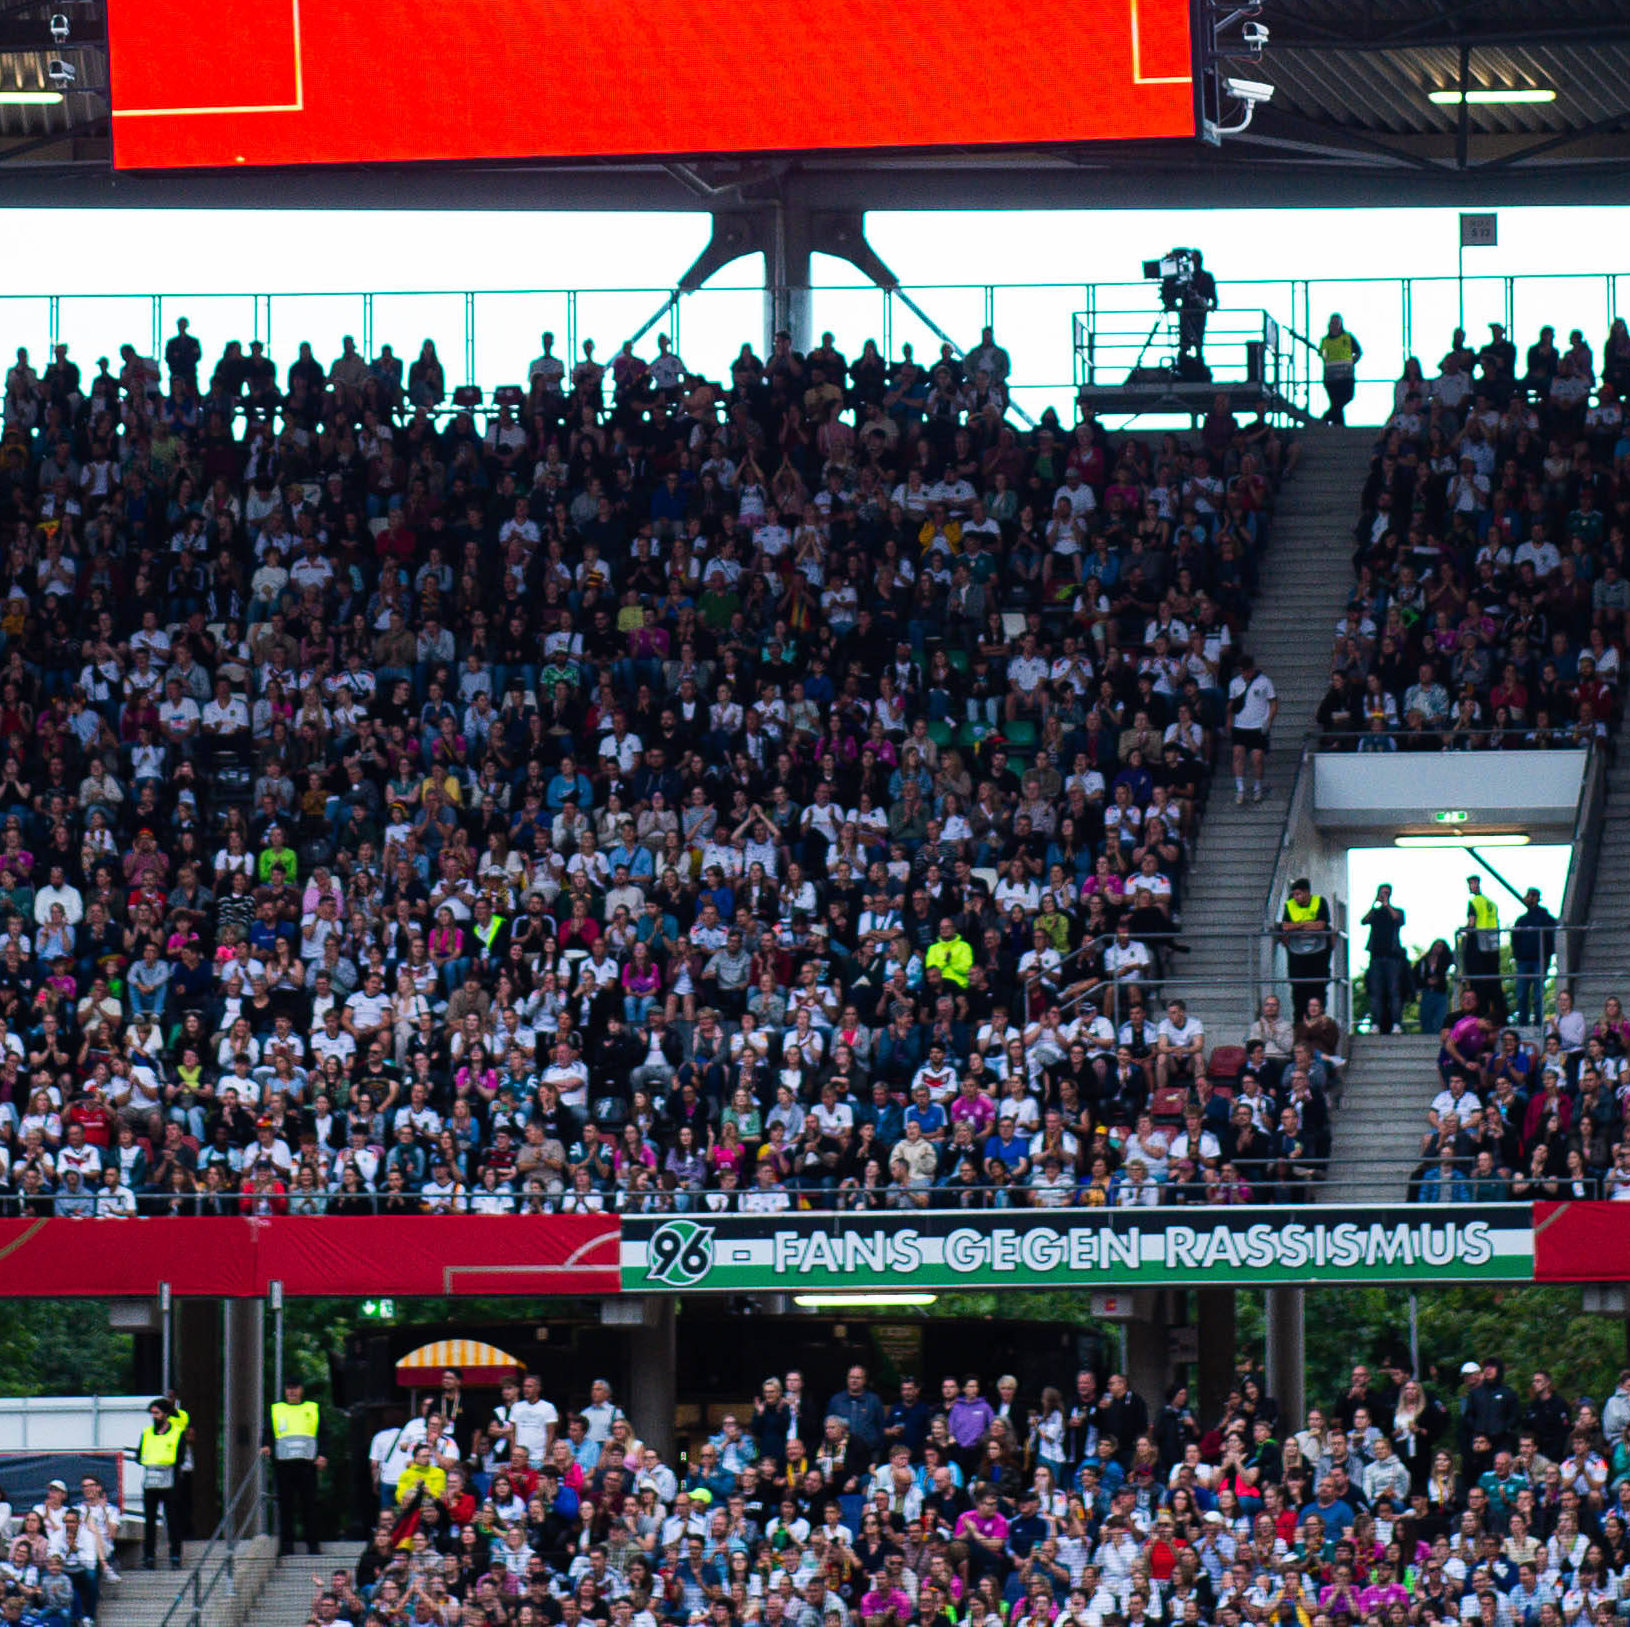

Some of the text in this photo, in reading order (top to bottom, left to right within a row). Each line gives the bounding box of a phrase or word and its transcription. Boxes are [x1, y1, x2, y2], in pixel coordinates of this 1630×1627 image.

[645, 1224, 715, 1281] 96
[773, 1227, 922, 1274] FANS
[943, 1225, 1140, 1272] GEGEN
[1164, 1221, 1495, 1270] RASSISMUS
